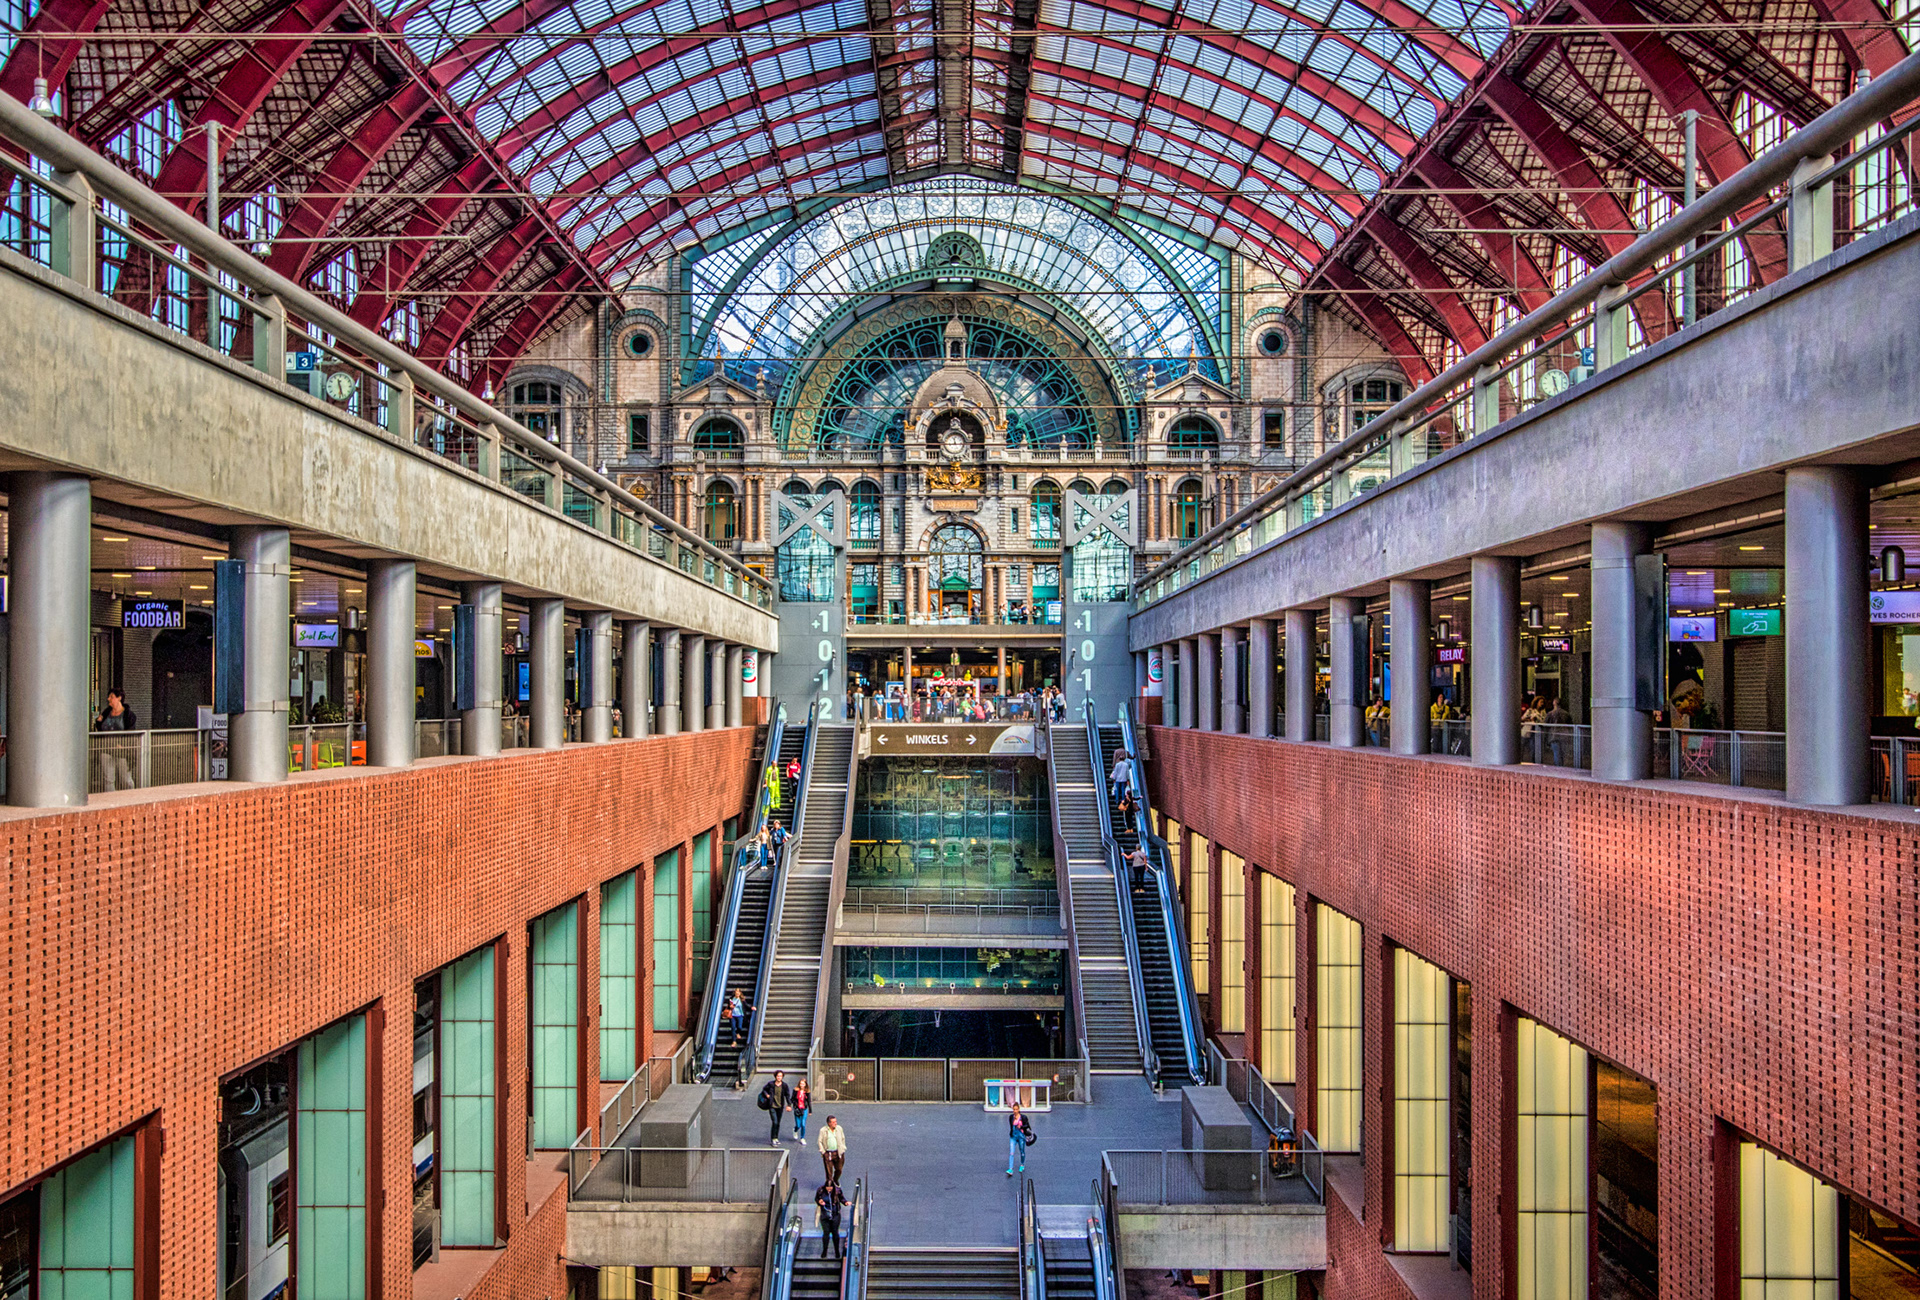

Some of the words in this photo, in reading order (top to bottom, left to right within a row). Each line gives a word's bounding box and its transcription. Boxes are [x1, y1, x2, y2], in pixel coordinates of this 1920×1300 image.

[302, 357, 308, 367] 3
[124, 611, 181, 627] FOODBAR
[811, 610, 829, 632] +1
[1073, 610, 1091, 632] +1
[818, 640, 832, 661] 0
[1081, 640, 1095, 661] 0
[1440, 649, 1462, 661] RELAY
[813, 669, 829, 691] -1
[1076, 668, 1091, 691] -1
[818, 697, 832, 719] 2
[906, 734, 948, 745] WINKELS
